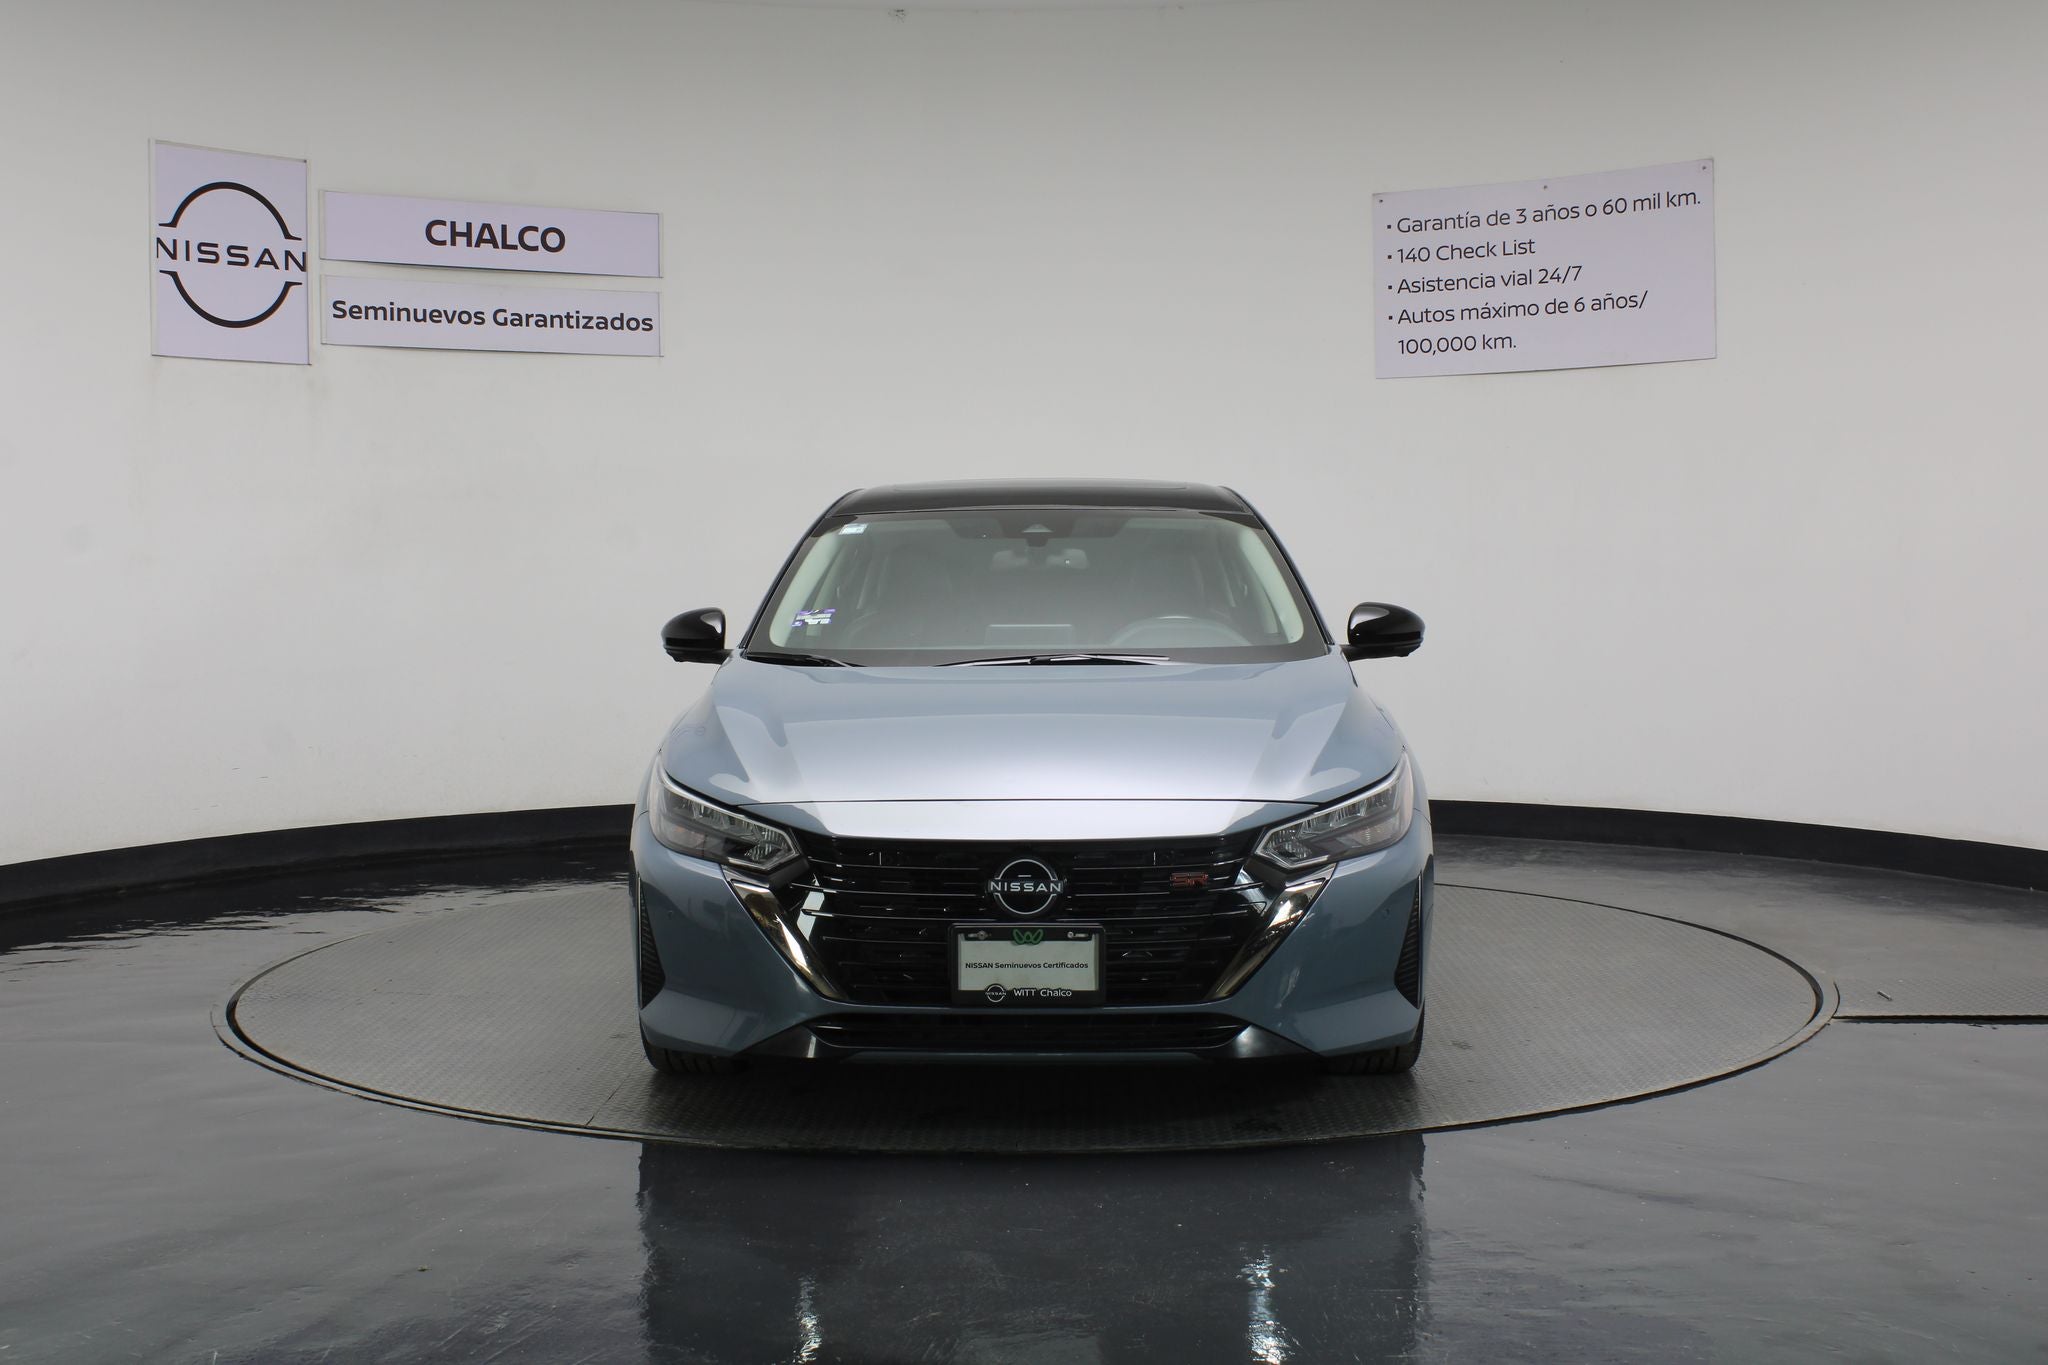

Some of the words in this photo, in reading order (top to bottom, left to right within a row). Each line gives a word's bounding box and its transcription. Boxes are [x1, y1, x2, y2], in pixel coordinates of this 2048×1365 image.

[1397, 210, 1481, 234] Garantía
[1486, 210, 1511, 227] de
[1515, 208, 1528, 225] 3
[1532, 203, 1580, 224] años
[1584, 204, 1598, 218] o
[1602, 197, 1628, 216] 60
[1632, 192, 1662, 213] mil
[1666, 189, 1702, 209] km.
[424, 219, 567, 254] CHALCO
[1397, 246, 1431, 264] 140
[1435, 241, 1498, 262] Check
[1502, 238, 1537, 257] List
[155, 236, 308, 273] NISSAN
[1397, 272, 1497, 294] Asistencia
[1500, 269, 1533, 288] vial
[1538, 265, 1584, 285] 24/7
[331, 299, 487, 327] Seminuevos
[491, 306, 655, 333] Garantizados
[1397, 306, 1456, 325] Autos
[1460, 300, 1540, 321] máximo
[1544, 297, 1569, 315] de
[1573, 296, 1587, 314] 6
[1590, 290, 1649, 312] años/
[1397, 335, 1478, 357] 100,000
[1481, 332, 1518, 351] km.
[989, 880, 1063, 893] NISSAN
[994, 961, 1042, 969] Seminuevos
[1042, 961, 1089, 969] Certificados
[1013, 988, 1037, 997] WITT
[1039, 988, 1073, 998] Chalco
